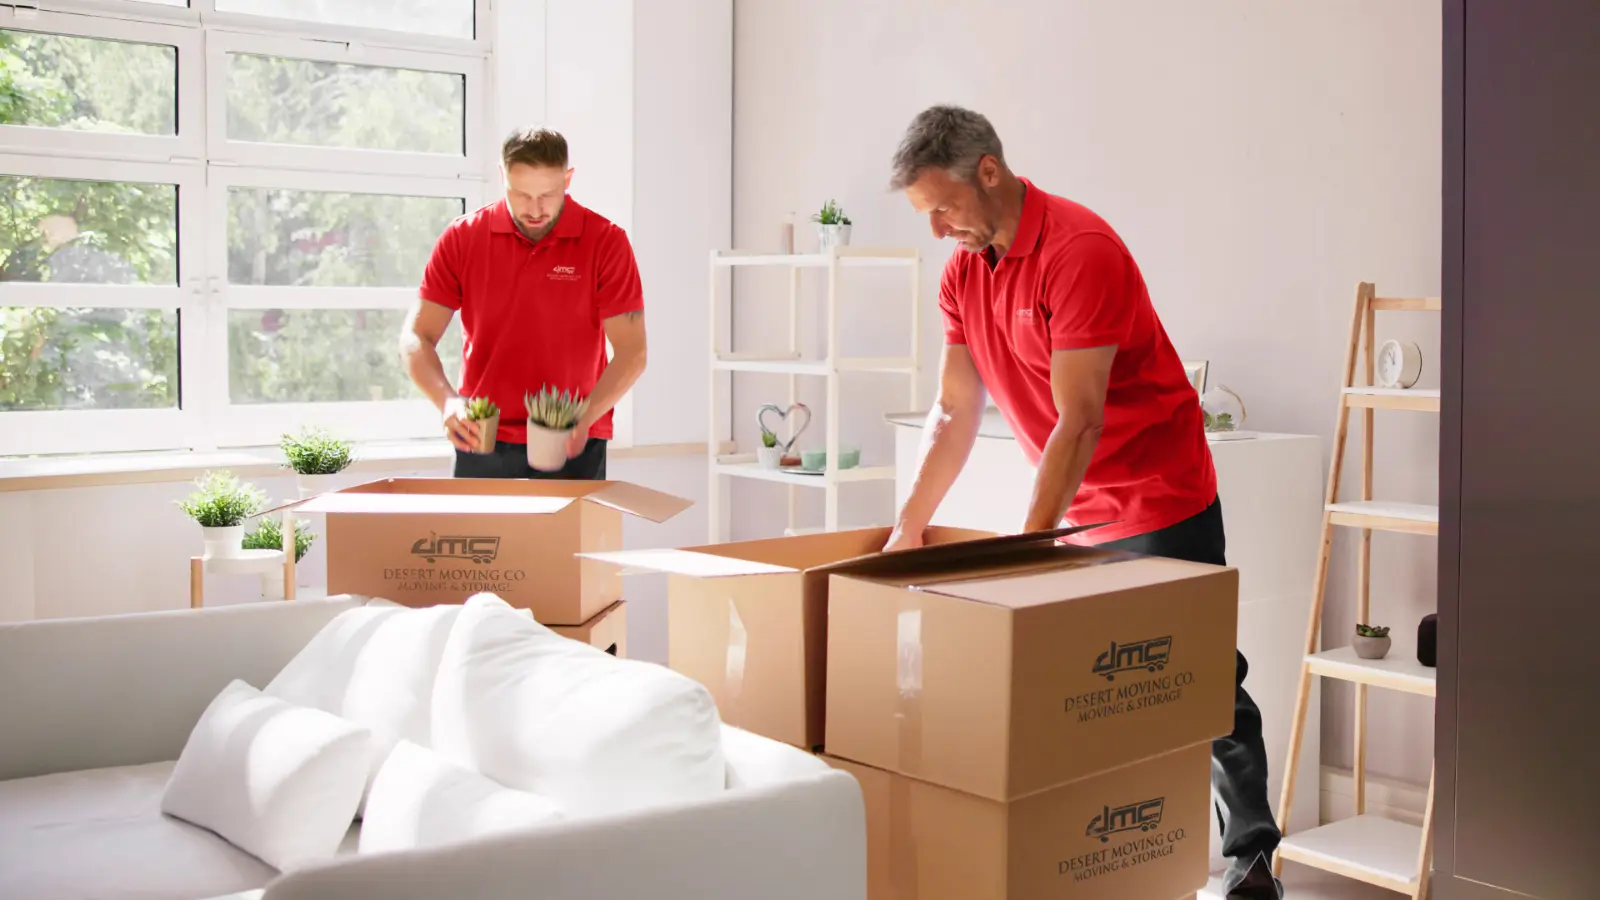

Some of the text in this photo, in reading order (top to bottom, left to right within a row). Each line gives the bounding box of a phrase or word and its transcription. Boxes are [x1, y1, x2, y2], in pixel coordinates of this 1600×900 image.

[384, 568, 435, 580] DESERT
[439, 569, 499, 581] MOVING
[1064, 671, 1195, 713] DESERT MOVING CO.
[1077, 689, 1182, 724] MOVING & STORAGE
[1058, 828, 1187, 875] DESERT MOVING CO.
[1073, 844, 1175, 884] MOVING & STORAGE
